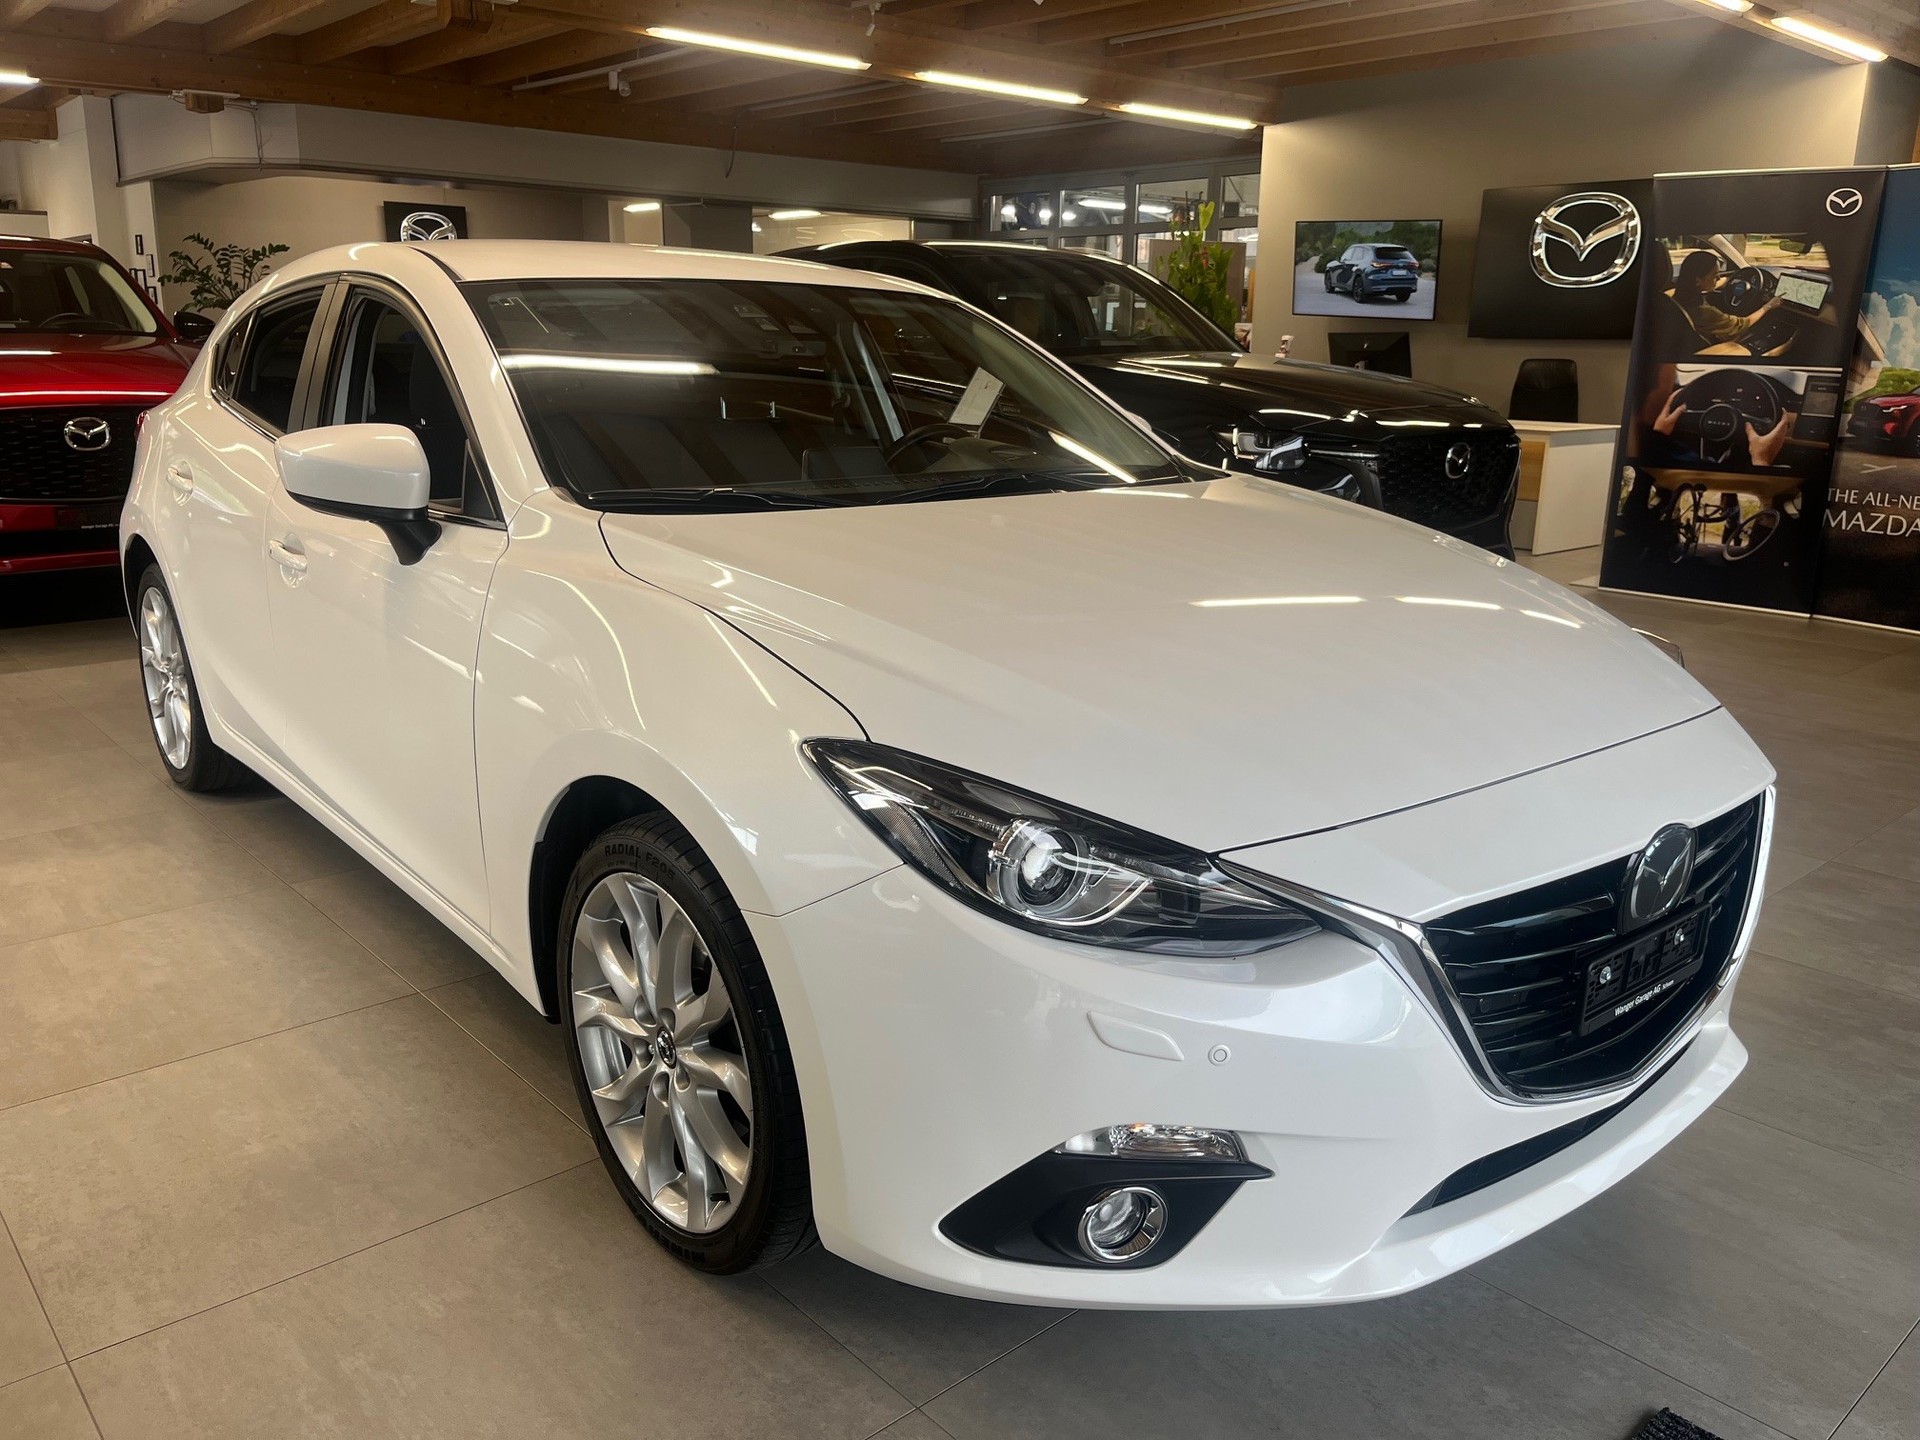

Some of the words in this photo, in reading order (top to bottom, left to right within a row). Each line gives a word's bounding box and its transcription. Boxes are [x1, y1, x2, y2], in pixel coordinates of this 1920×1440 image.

[1827, 487, 1859, 505] THE
[1821, 508, 1920, 538] MAZDA
[604, 843, 641, 859] RADIAL
[1634, 990, 1653, 1005] Garage
[1652, 983, 1662, 995] AG
